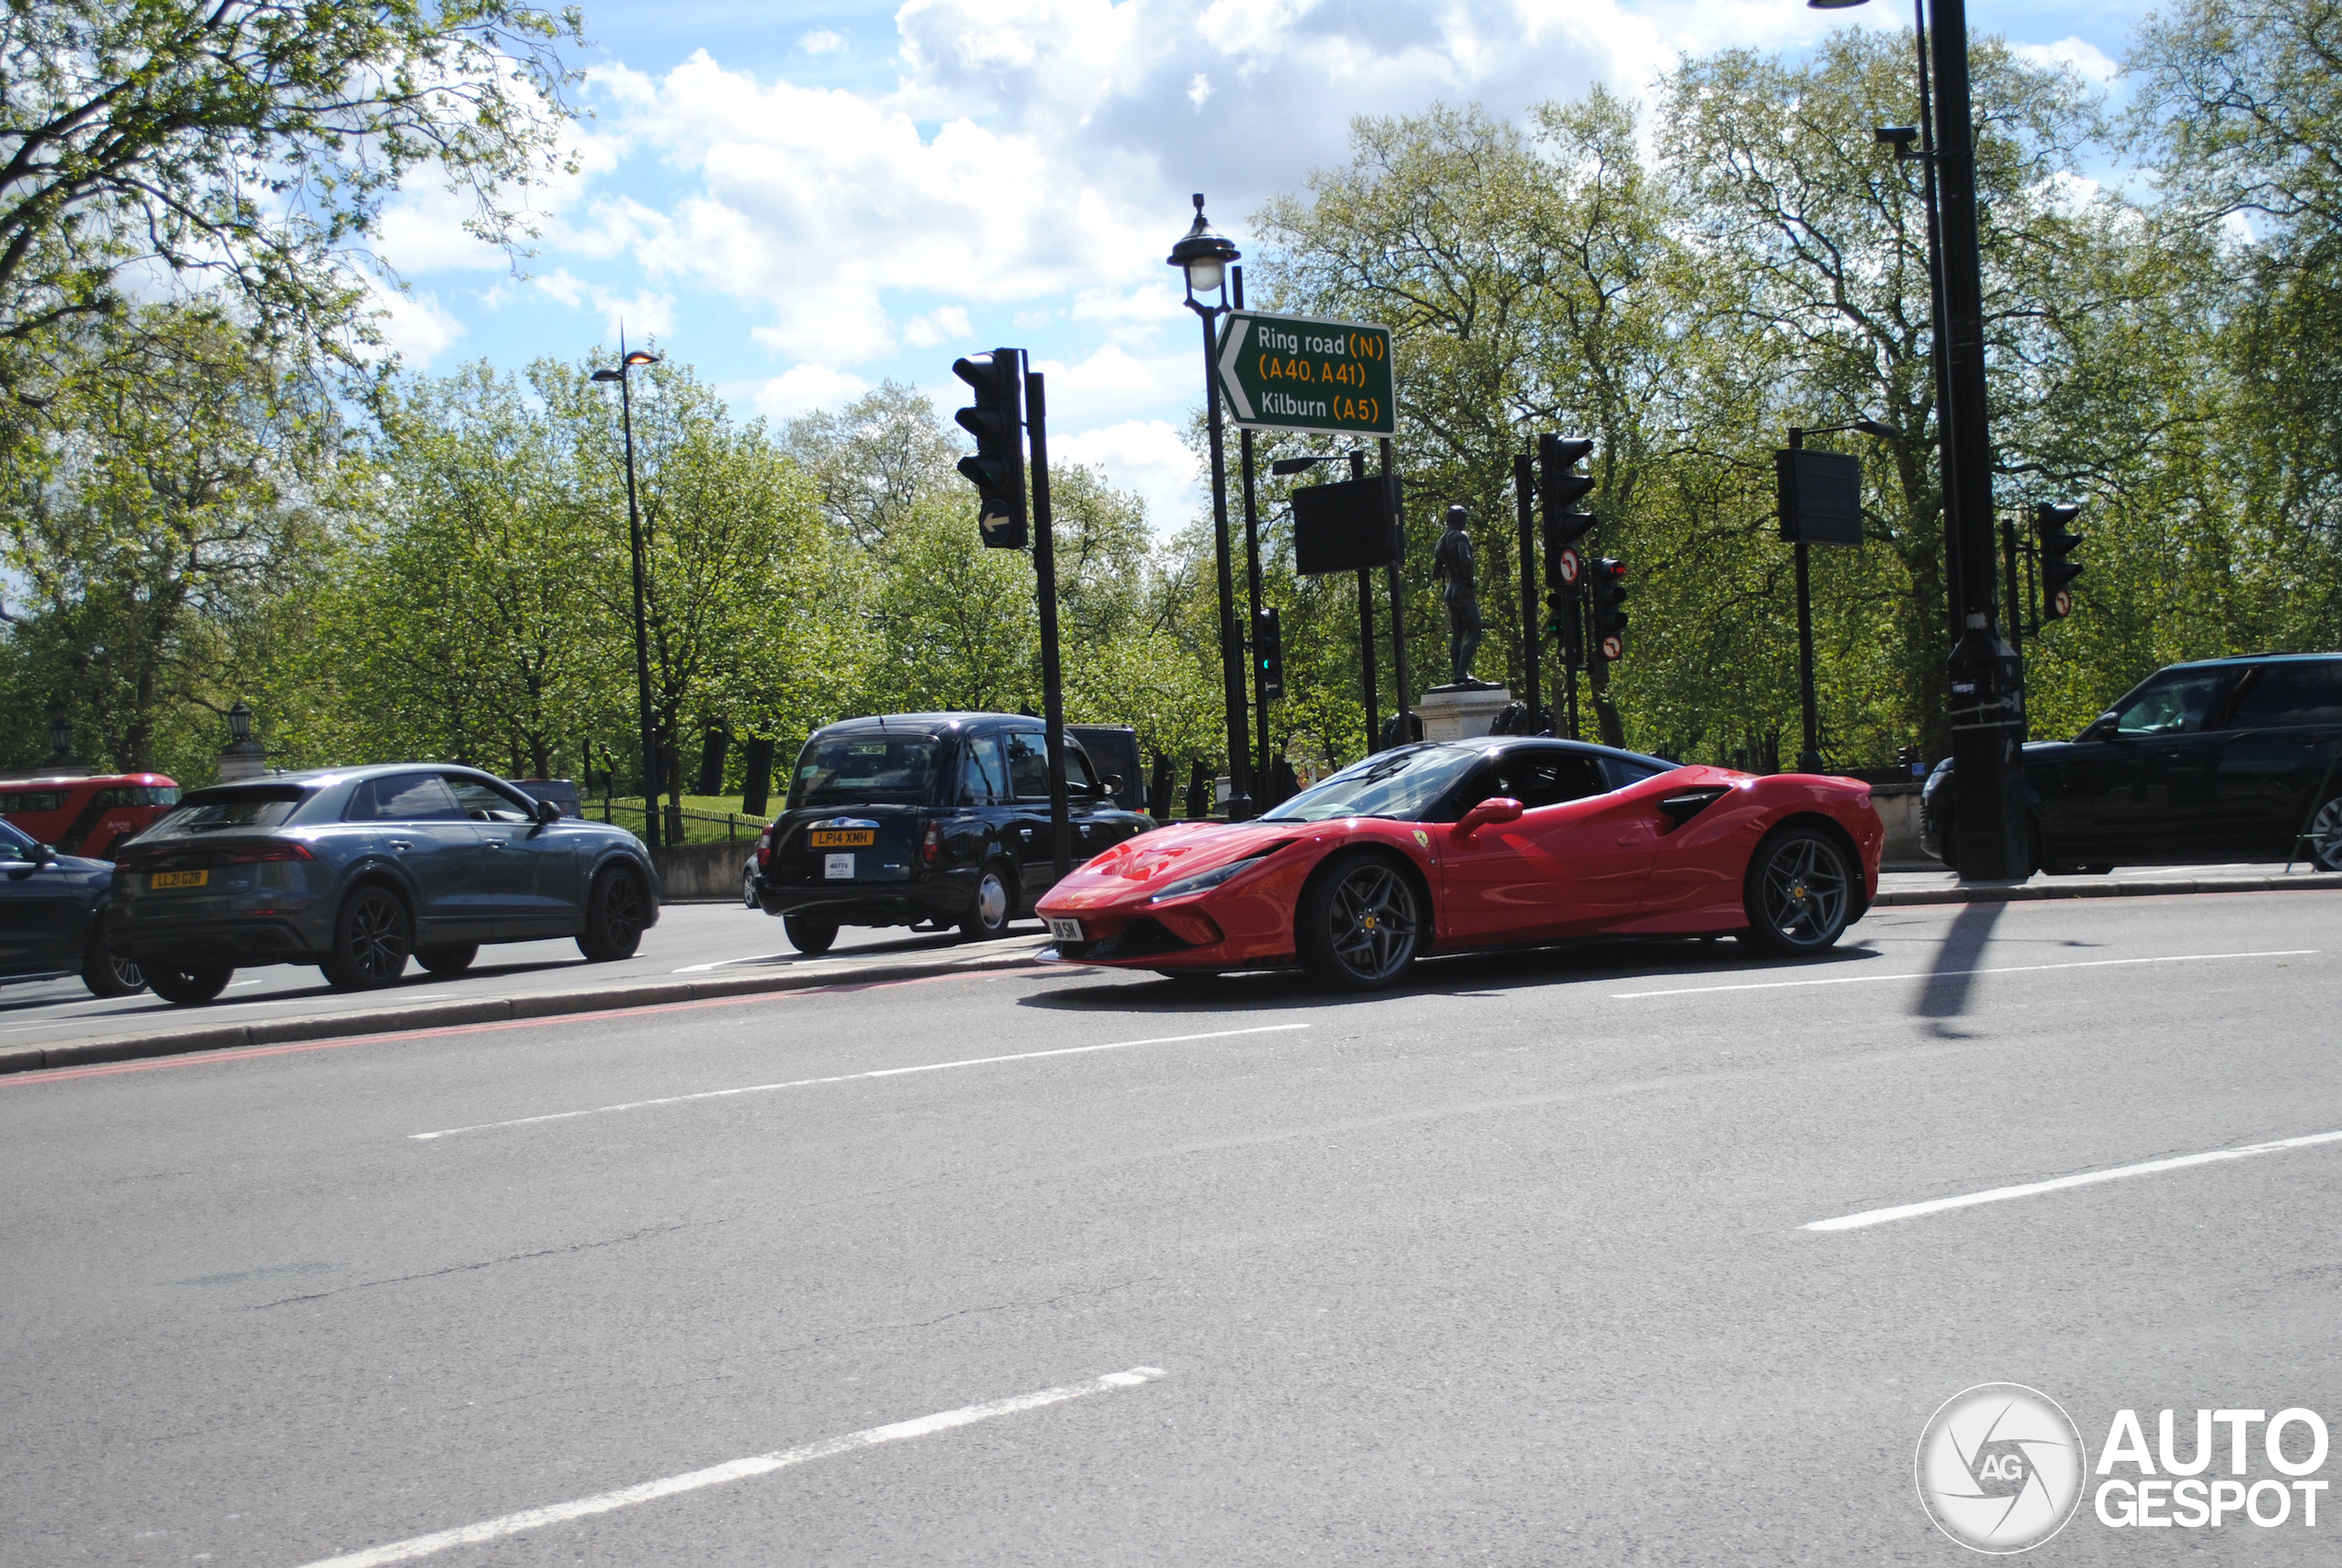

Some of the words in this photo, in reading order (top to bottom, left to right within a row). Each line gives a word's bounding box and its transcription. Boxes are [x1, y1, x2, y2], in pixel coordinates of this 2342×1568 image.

[1258, 326, 1298, 355] Ring
[1305, 334, 1345, 355] road
[1349, 332, 1384, 361] (N)
[1259, 353, 1316, 384] (A40,
[1321, 361, 1366, 389] A41)
[1262, 392, 1327, 417] Kilburn
[1333, 394, 1379, 424] (A5)
[819, 832, 843, 844] LP14
[845, 832, 867, 843] XMH
[157, 872, 180, 886] LL21
[1062, 921, 1078, 939] SN
